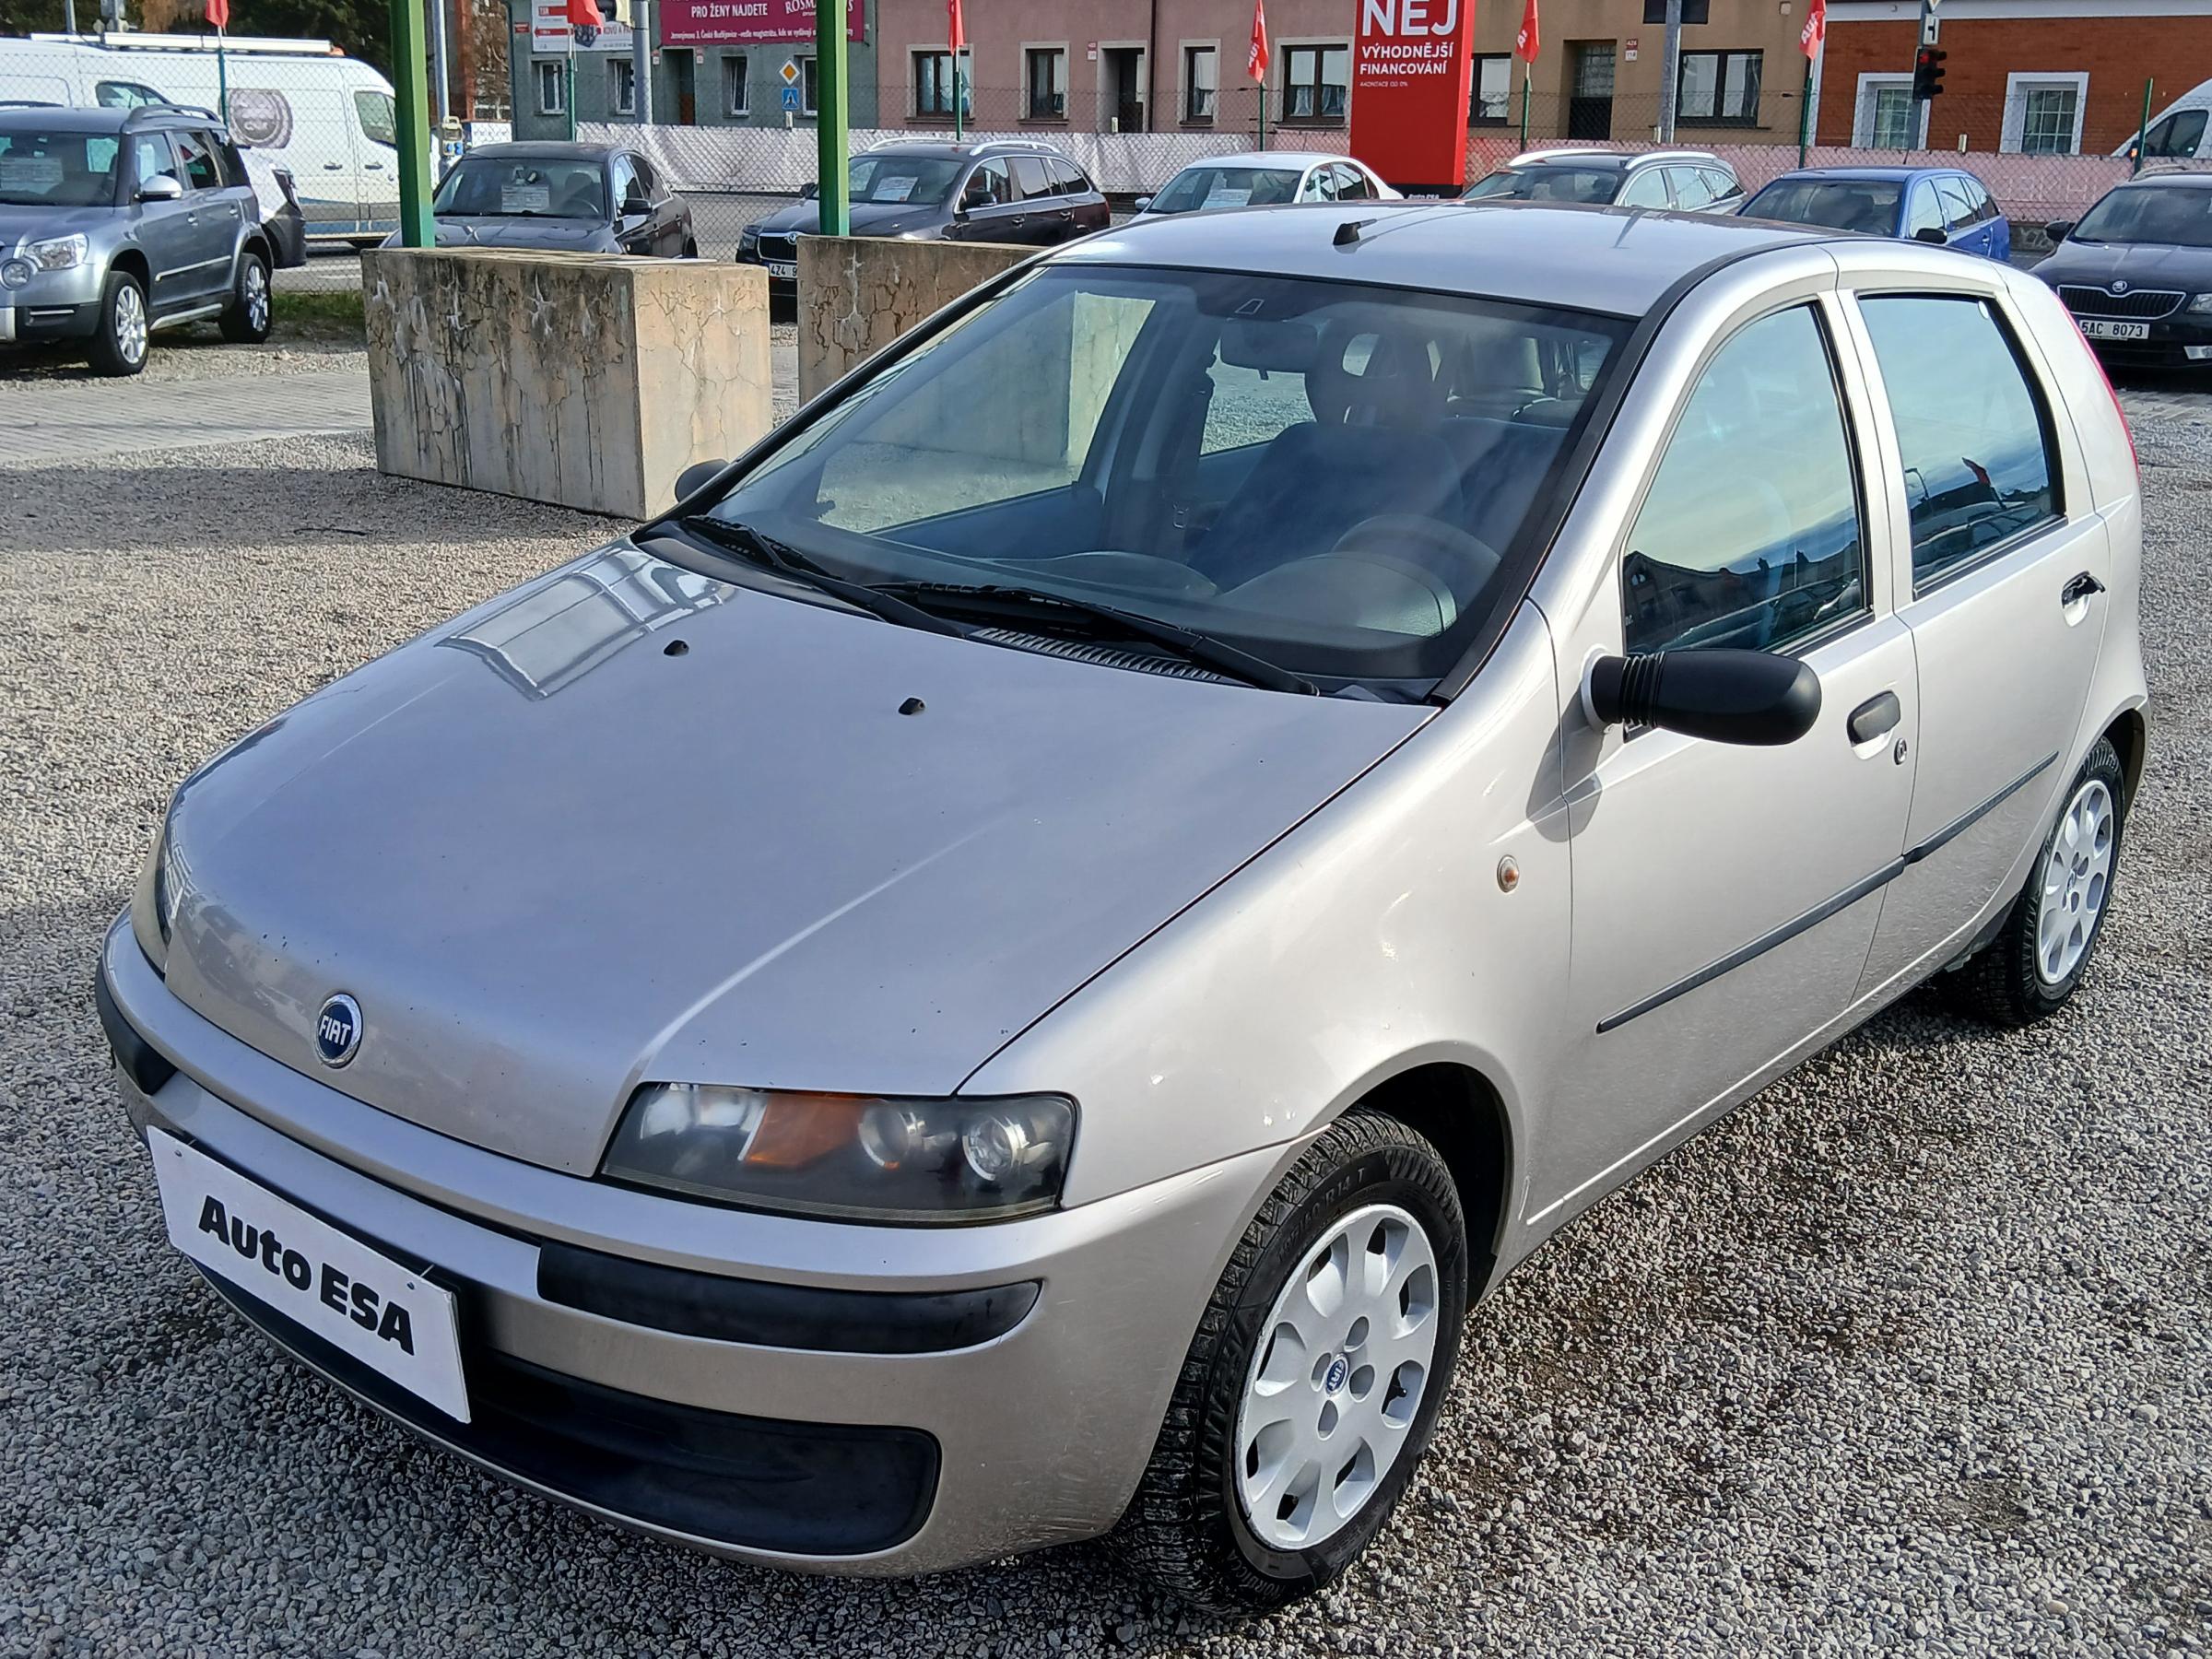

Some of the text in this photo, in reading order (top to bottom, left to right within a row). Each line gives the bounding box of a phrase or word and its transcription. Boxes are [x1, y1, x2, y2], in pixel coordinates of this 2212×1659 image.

[691, 3, 768, 18] PRO ŽENY NAJDETE
[1362, 0, 1457, 36] NEJ
[1362, 41, 1454, 59] VÝHODNĚJŠÍ
[1359, 60, 1447, 75] FINANCOVÁNÍ
[771, 265, 786, 276] 4Z4
[2081, 322, 2143, 337] 5AC 8073
[319, 1015, 351, 1045] FIAT
[198, 1194, 415, 1357] Auto ESA
[1328, 1360, 1344, 1390] FIAT
